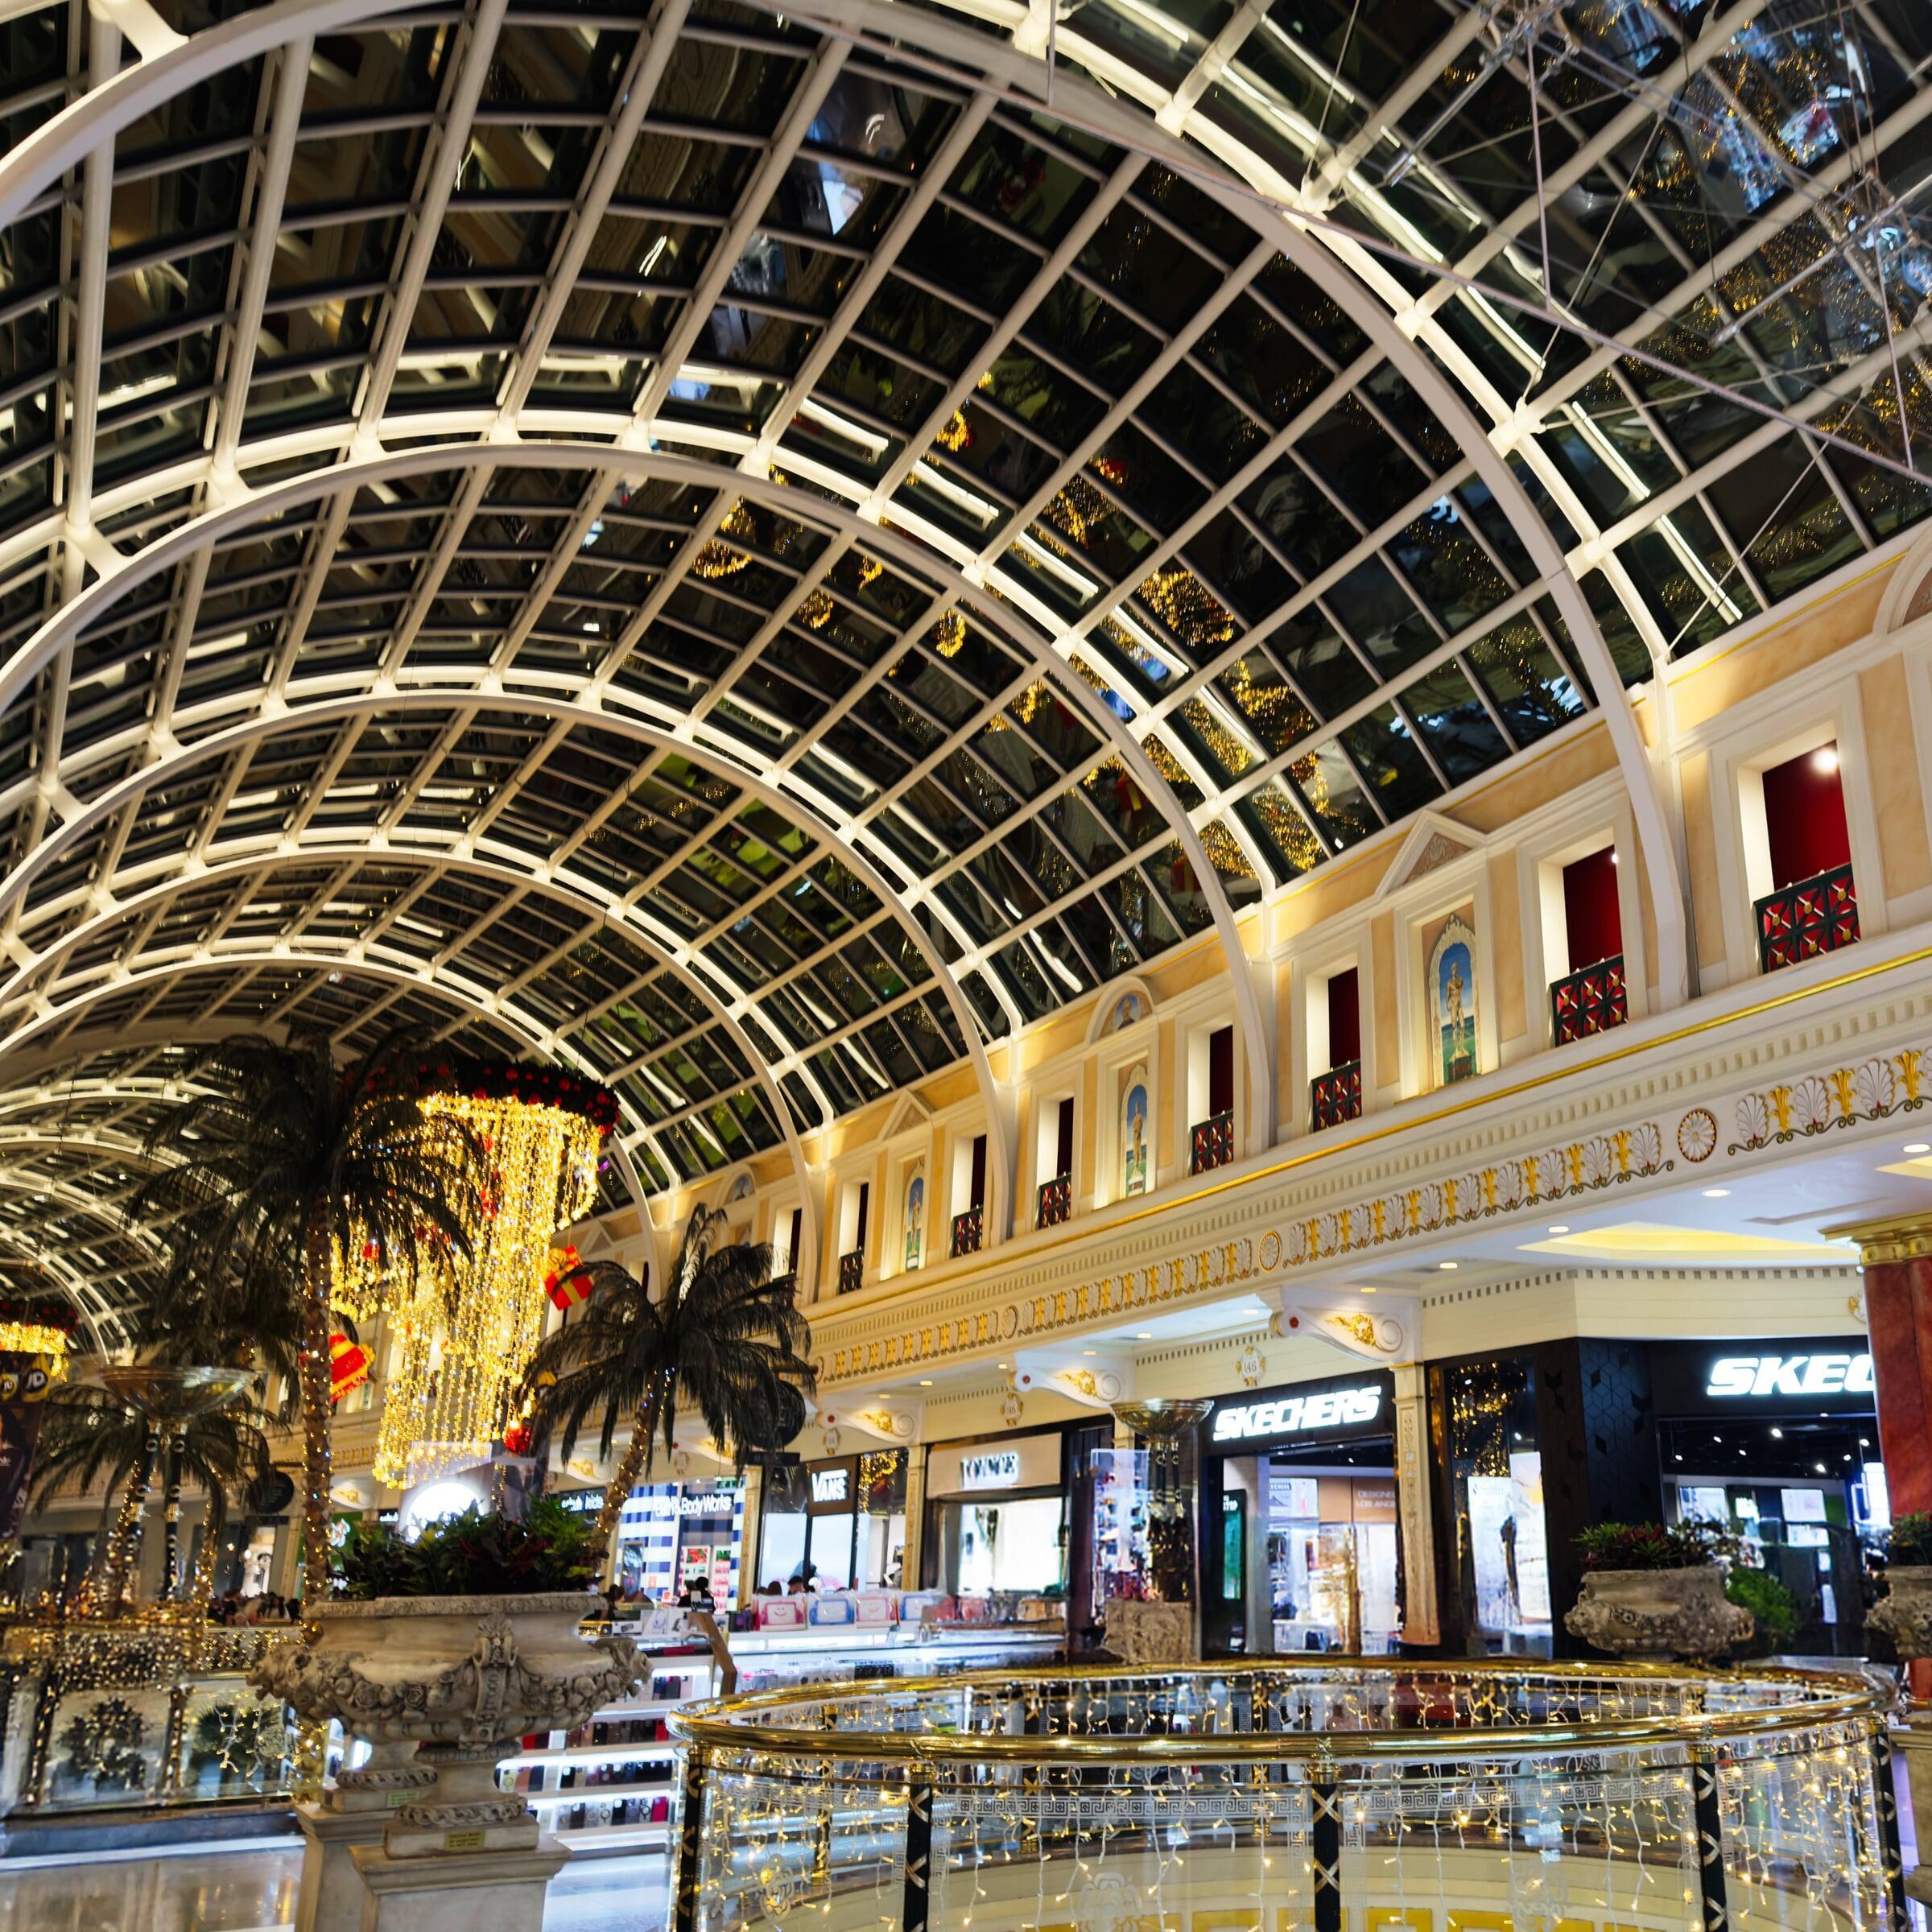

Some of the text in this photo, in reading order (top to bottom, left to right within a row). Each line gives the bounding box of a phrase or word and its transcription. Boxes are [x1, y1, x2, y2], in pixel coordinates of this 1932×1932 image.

[1213, 1385, 1381, 1442] SKECHERS
[811, 1469, 848, 1503] VANS
[681, 1496, 703, 1517] Body
[703, 1493, 732, 1513] Works
